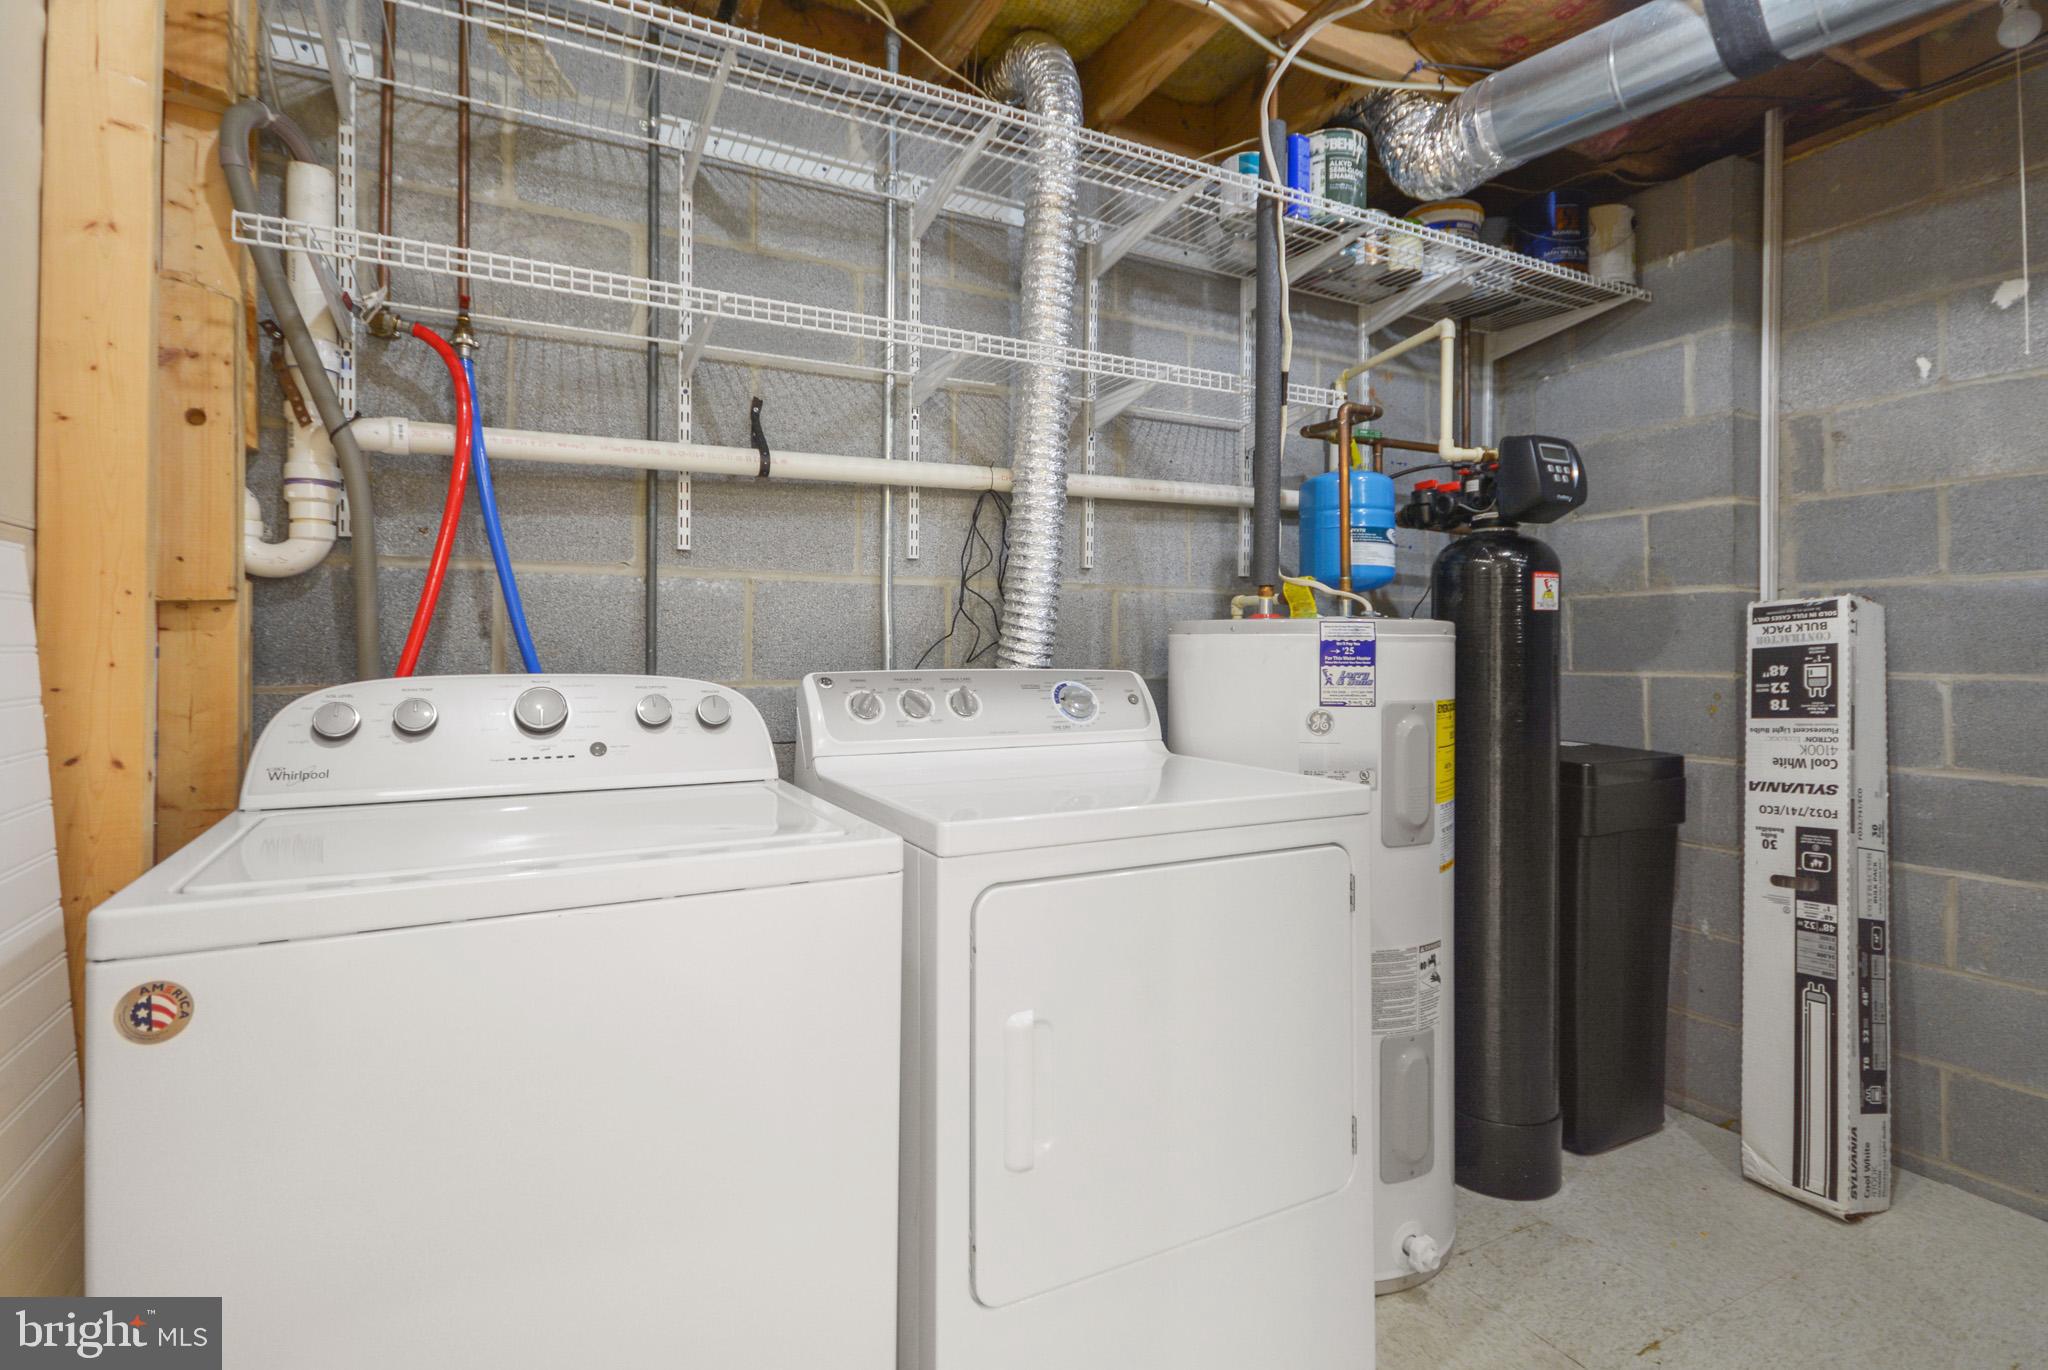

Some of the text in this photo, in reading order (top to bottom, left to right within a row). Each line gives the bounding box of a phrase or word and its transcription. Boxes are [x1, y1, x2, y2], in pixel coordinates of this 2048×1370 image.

[1762, 622, 1828, 635] BULK PACK
[1756, 632, 1832, 646] CONTRACTOR
[1762, 665, 1789, 678] 48"
[1770, 682, 1790, 694] 32
[1770, 699, 1790, 711] T8
[1800, 744, 1839, 756] 4100K
[1772, 757, 1838, 770] Cool White
[268, 769, 330, 782] Whirlpool
[1749, 780, 1839, 795] SYLVANIA
[1759, 805, 1838, 819] FO32/741/ECO
[1762, 839, 1778, 850] 30
[1804, 921, 1817, 930] 32
[140, 984, 190, 1020] AMERICA
